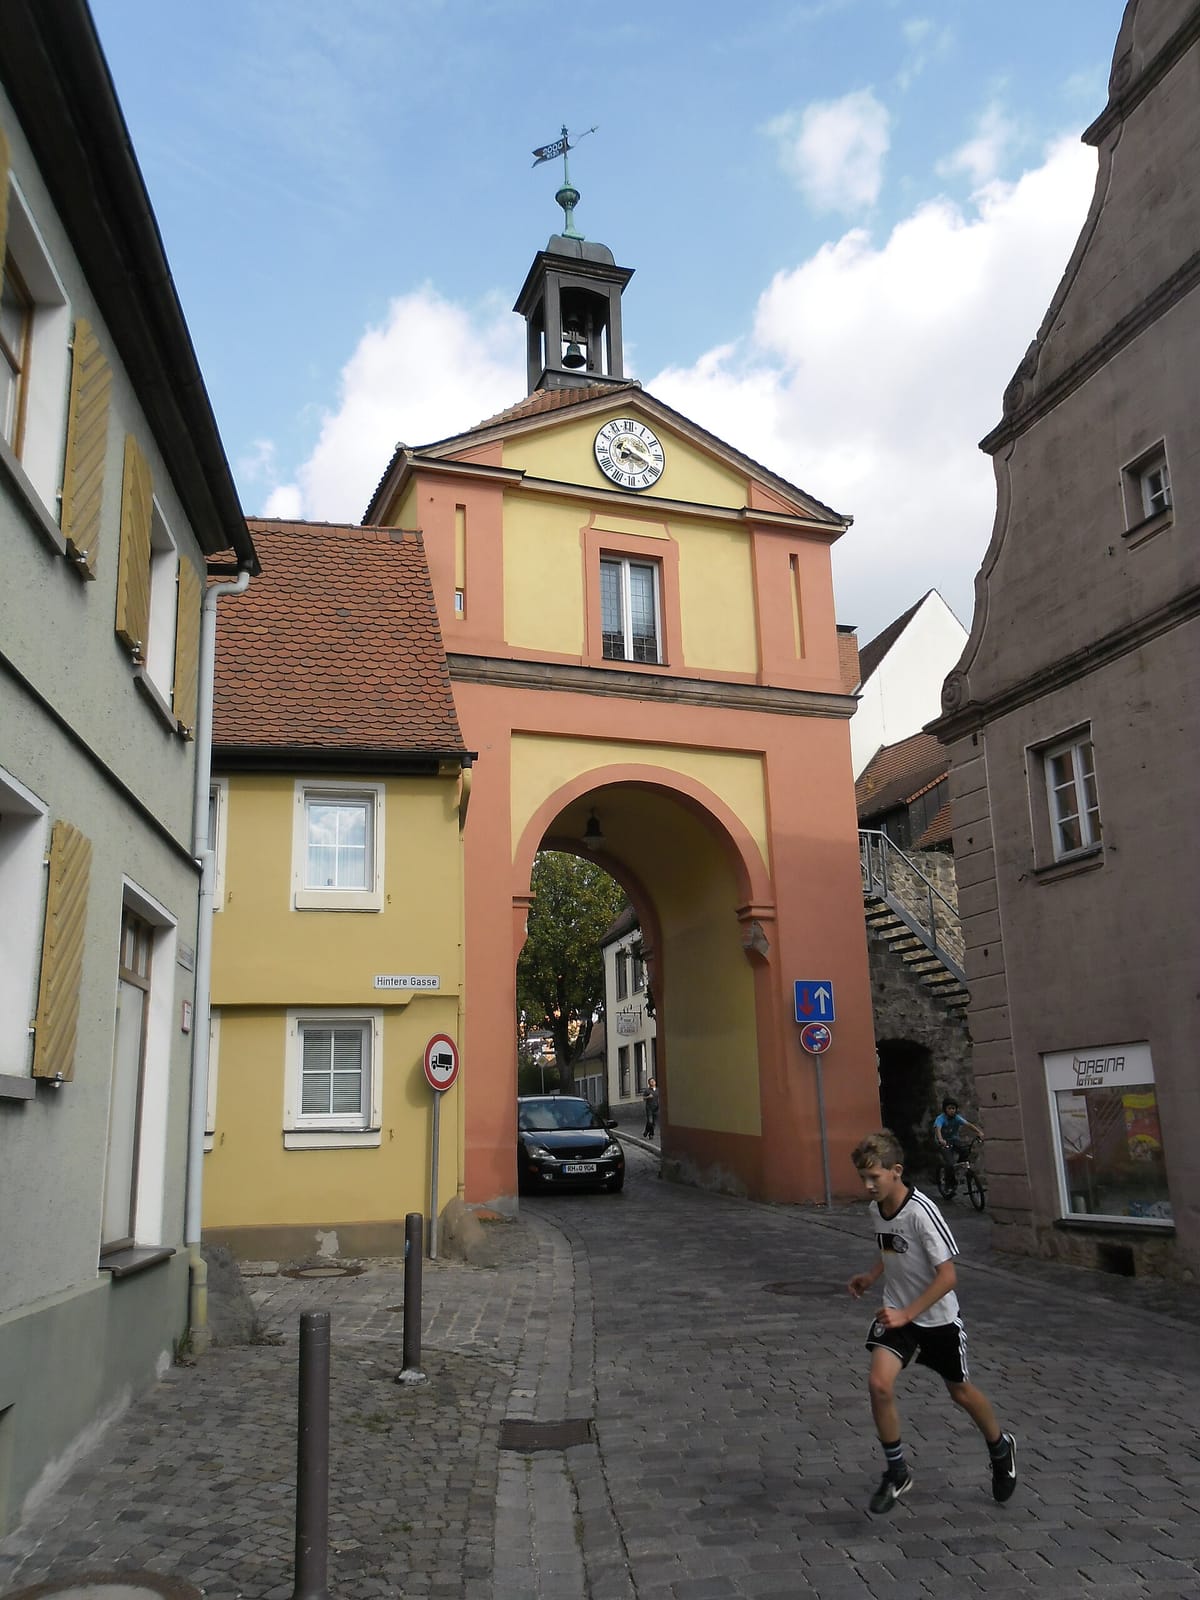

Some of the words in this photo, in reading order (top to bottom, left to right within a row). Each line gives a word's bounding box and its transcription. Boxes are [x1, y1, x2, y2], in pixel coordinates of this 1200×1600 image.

[377, 977, 407, 986] Hintere
[410, 977, 437, 986] Gasse
[1077, 1057, 1125, 1079] PAGINA
